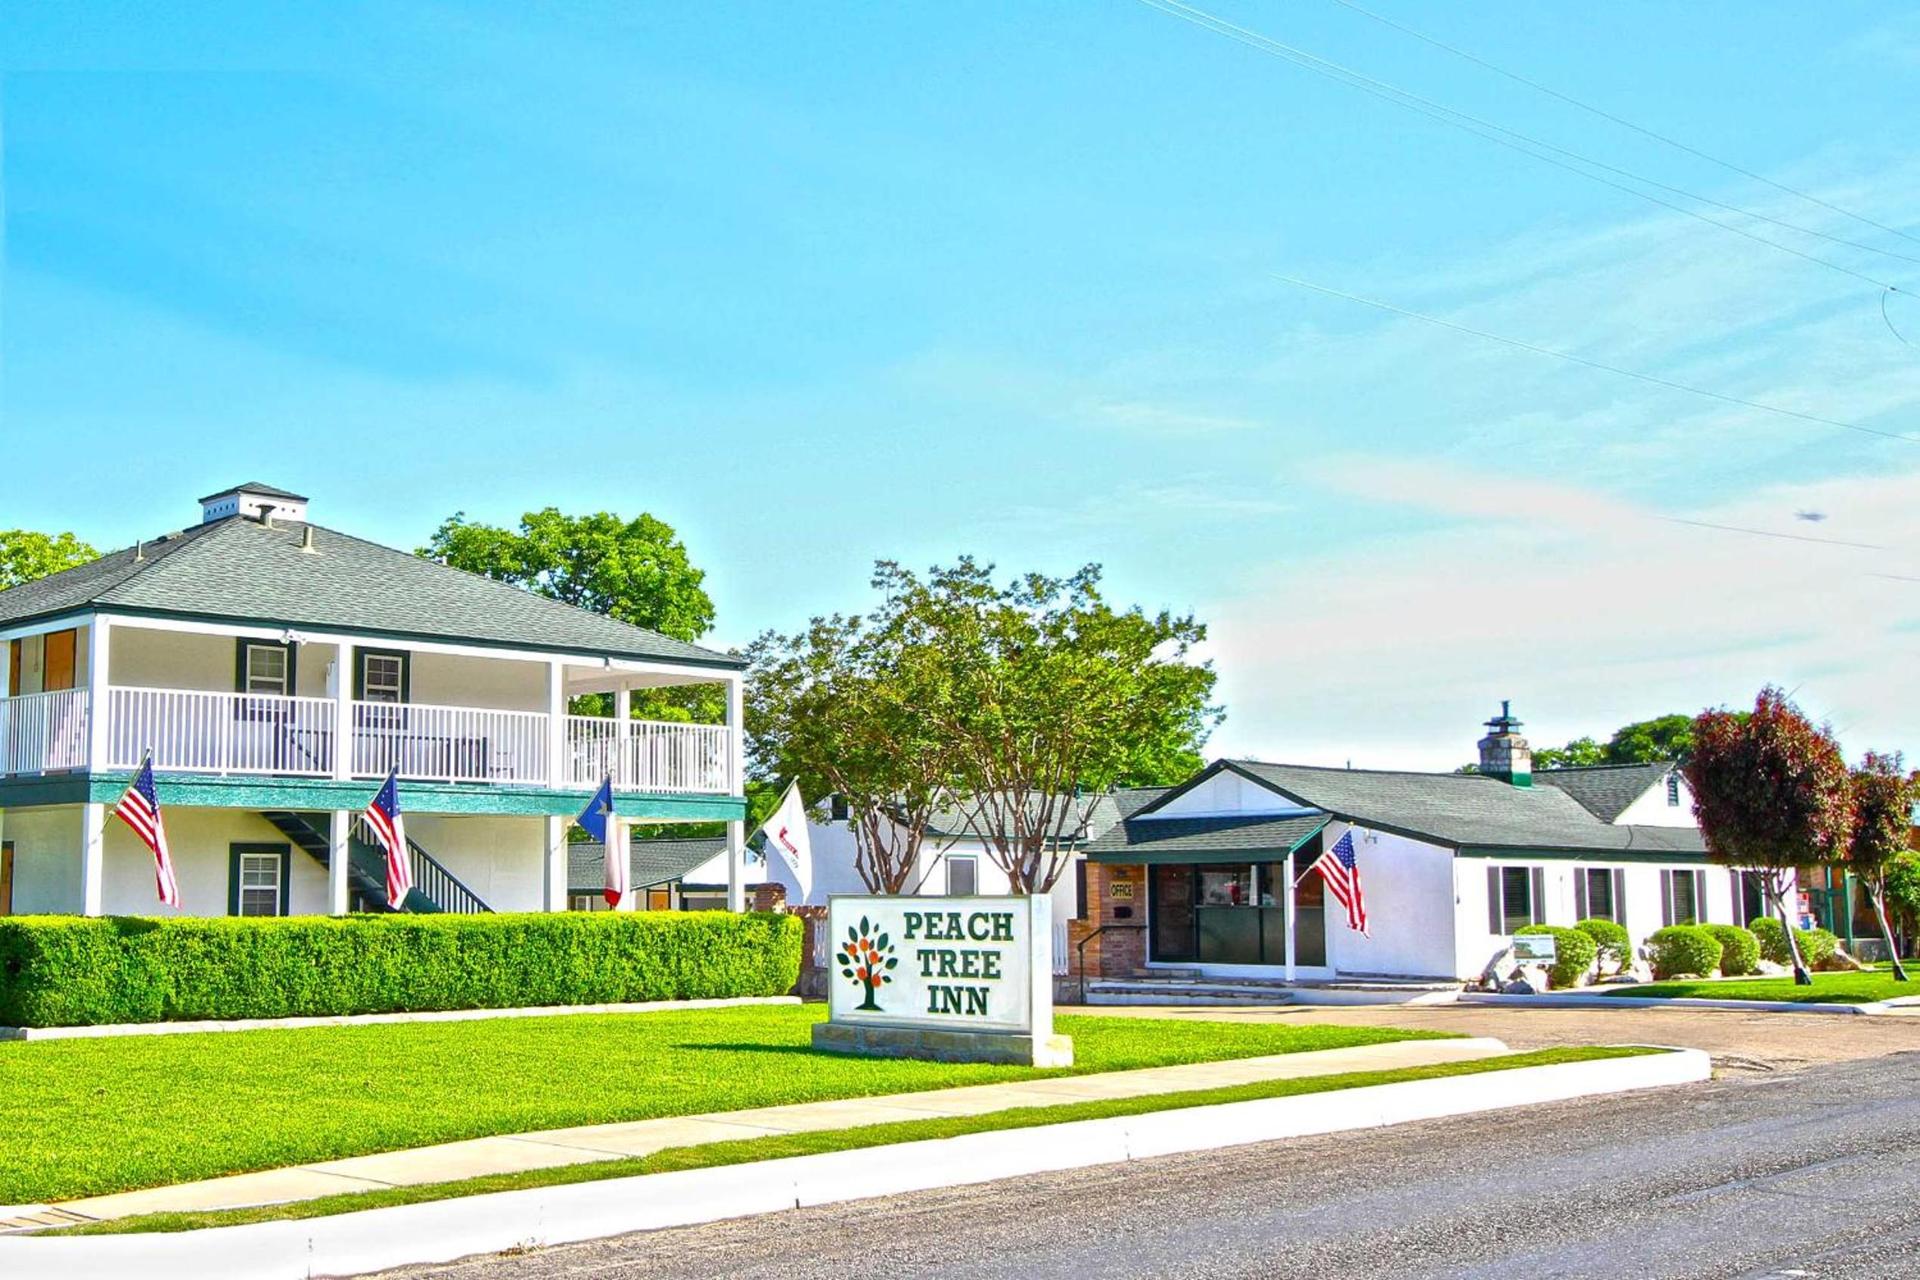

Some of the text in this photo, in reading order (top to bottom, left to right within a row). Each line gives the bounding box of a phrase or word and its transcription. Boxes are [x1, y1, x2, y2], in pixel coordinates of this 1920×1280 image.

[1111, 884, 1132, 897] OFFICE
[903, 912, 1014, 941] PEACH
[917, 949, 1001, 979] TREE
[927, 985, 990, 1016] INN
